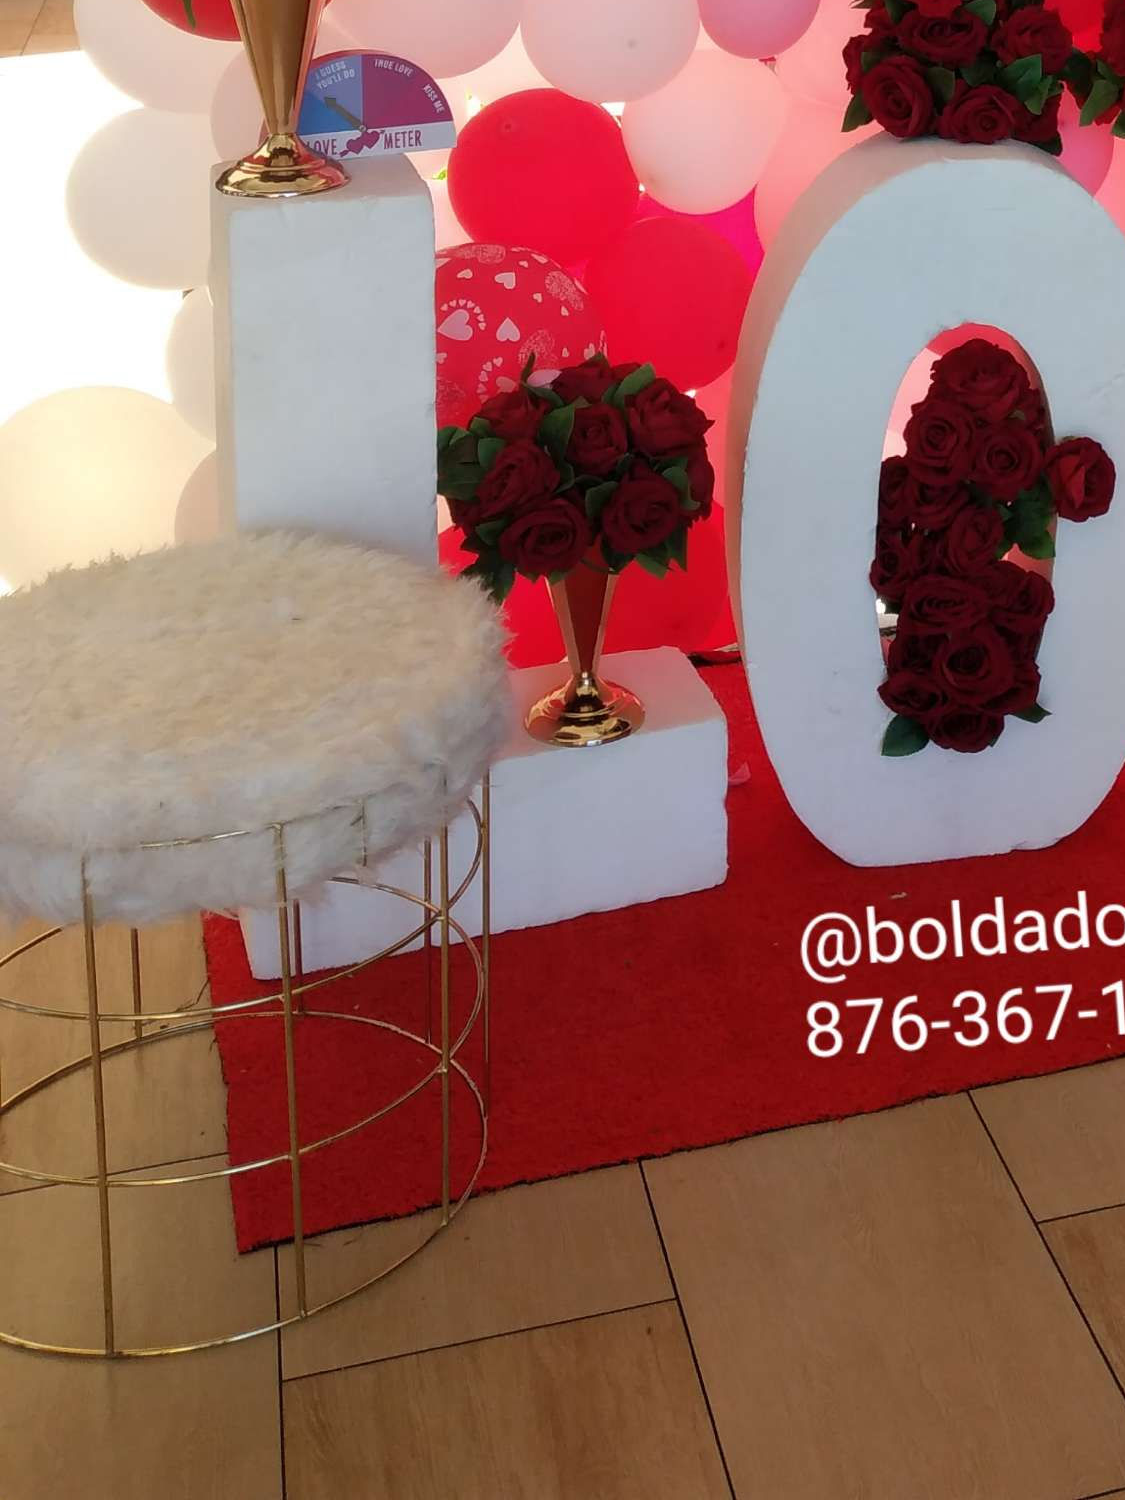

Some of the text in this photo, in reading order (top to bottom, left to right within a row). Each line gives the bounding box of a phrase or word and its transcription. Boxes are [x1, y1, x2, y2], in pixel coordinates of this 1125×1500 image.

[343, 68, 356, 80] DO
[374, 58, 414, 77] TRUE LOVE
[423, 84, 446, 114] KISS ME
[383, 129, 423, 150] METER
